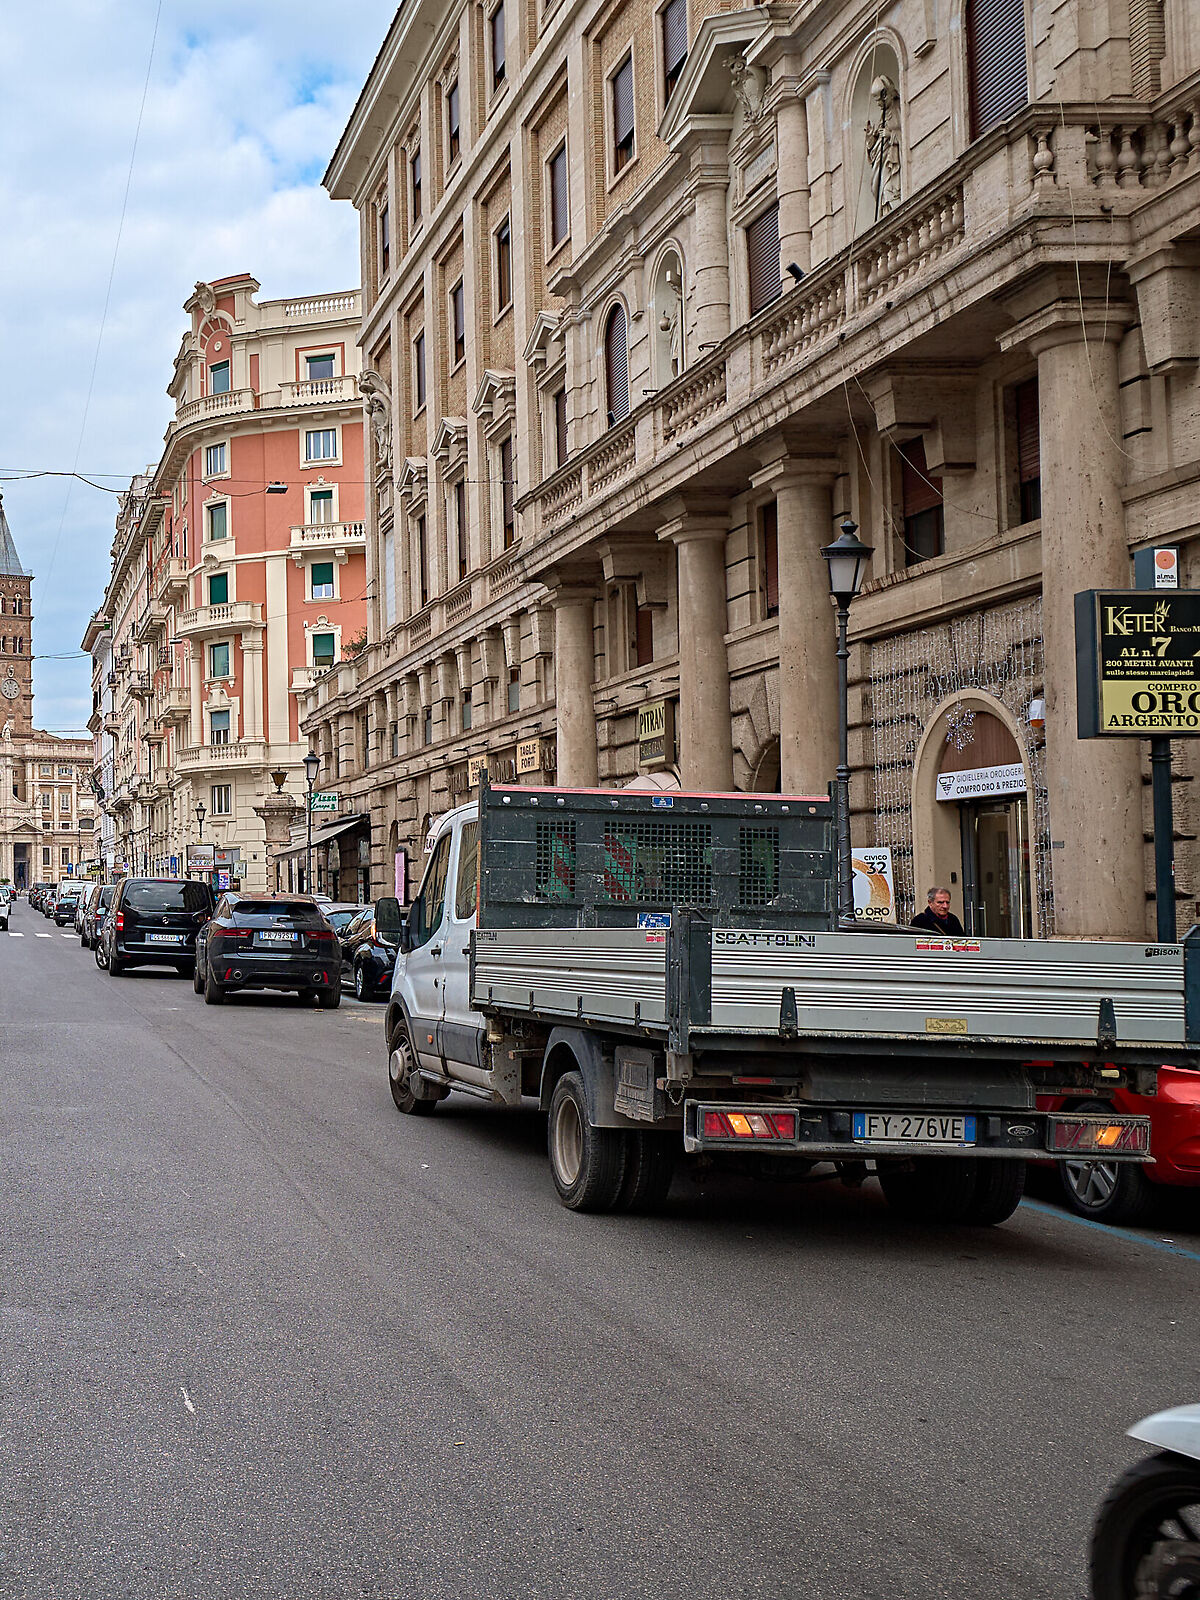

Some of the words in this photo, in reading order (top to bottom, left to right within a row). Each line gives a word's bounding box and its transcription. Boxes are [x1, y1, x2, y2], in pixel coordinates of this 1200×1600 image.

[1120, 647, 1139, 657] AL
[1151, 636, 1172, 657] 7
[1150, 669, 1195, 678] marciapiede
[1147, 683, 1197, 691] COMPRO
[1108, 714, 1198, 727] ARGENTO
[519, 743, 537, 756] TAGLIE
[956, 771, 989, 783] GIOIELLERIA
[956, 783, 980, 794] COMPRO
[982, 782, 994, 792] ORO
[996, 781, 1001, 790] &
[1002, 778, 1027, 789] PREZIOS
[311, 792, 337, 804] Pizza
[866, 861, 888, 875] 32
[865, 907, 890, 916] ORO
[715, 932, 816, 948] SCATTOLINI
